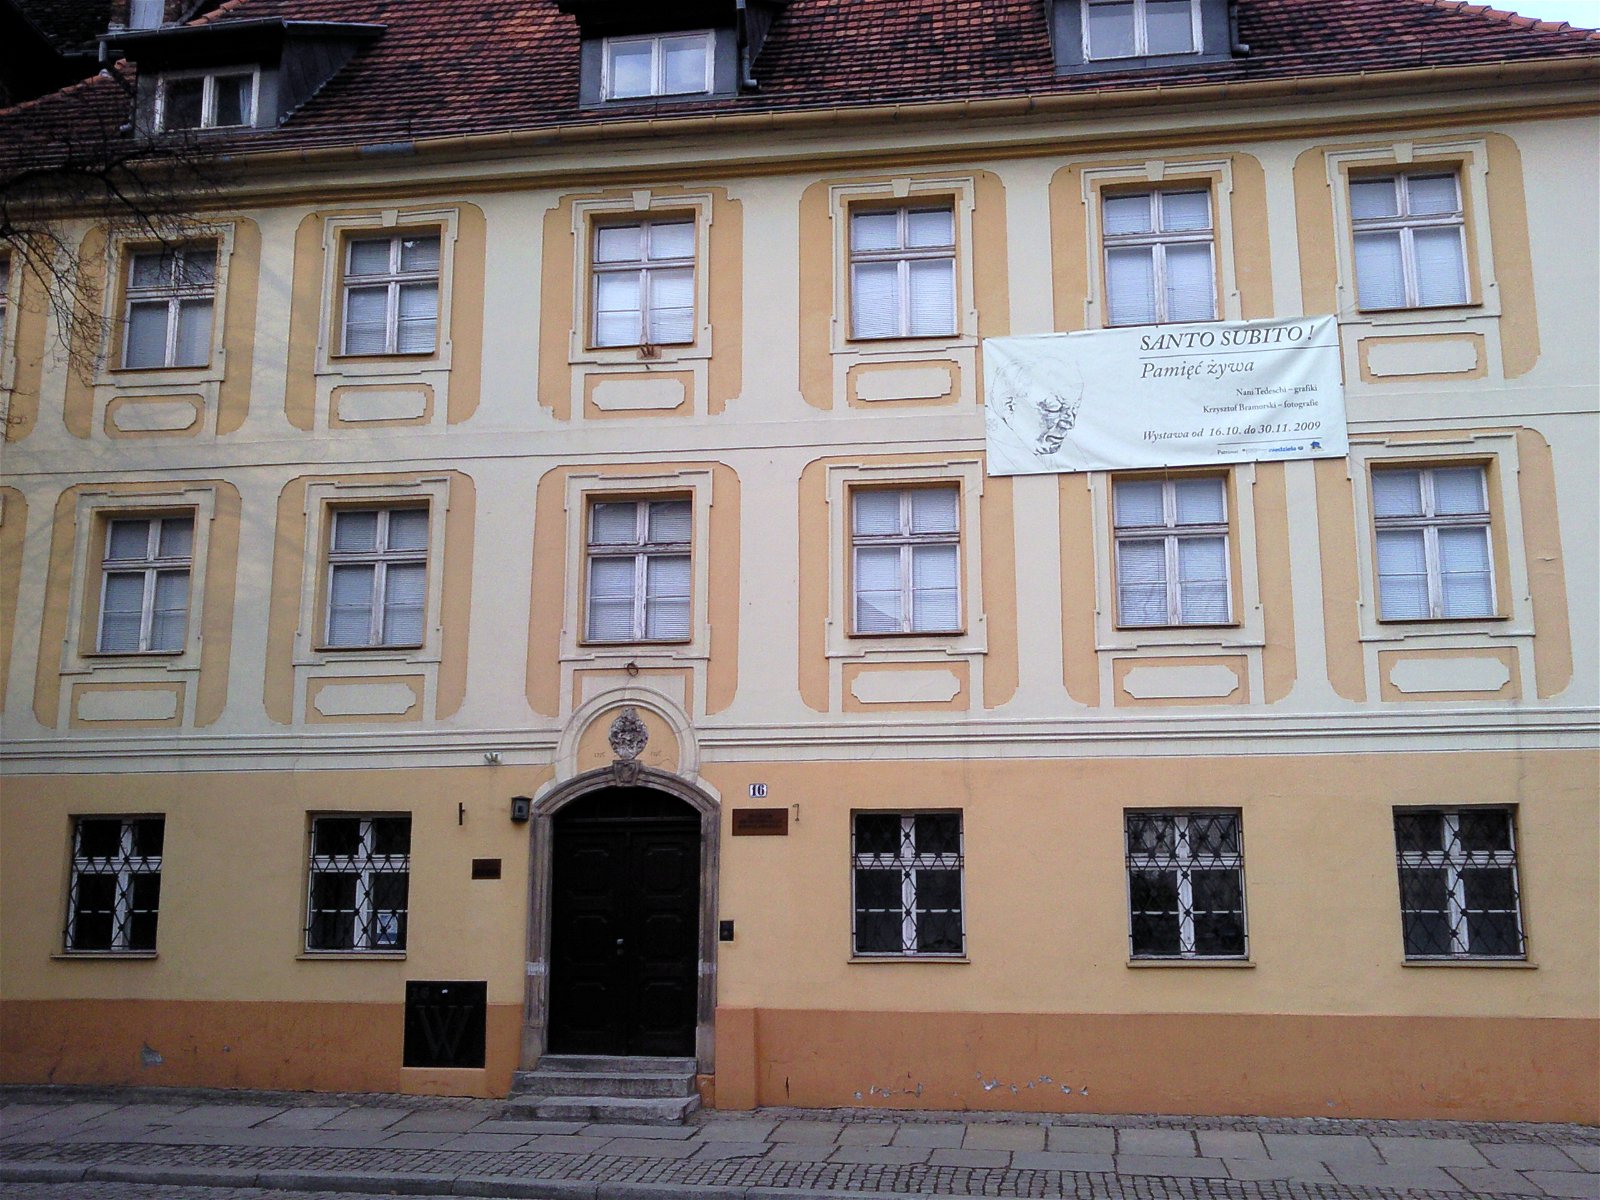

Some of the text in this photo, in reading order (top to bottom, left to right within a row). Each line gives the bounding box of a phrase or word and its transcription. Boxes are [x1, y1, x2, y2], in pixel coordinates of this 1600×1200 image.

[1140, 331, 1215, 351] SANTO
[1221, 325, 1303, 346] SUBITO
[1140, 359, 1255, 380] Pamięć żywa
[1203, 404, 1237, 415] Krzysztof
[1143, 420, 1321, 444] Wystawa od 16.10. do 30.11. 2009
[752, 784, 765, 796] 16
